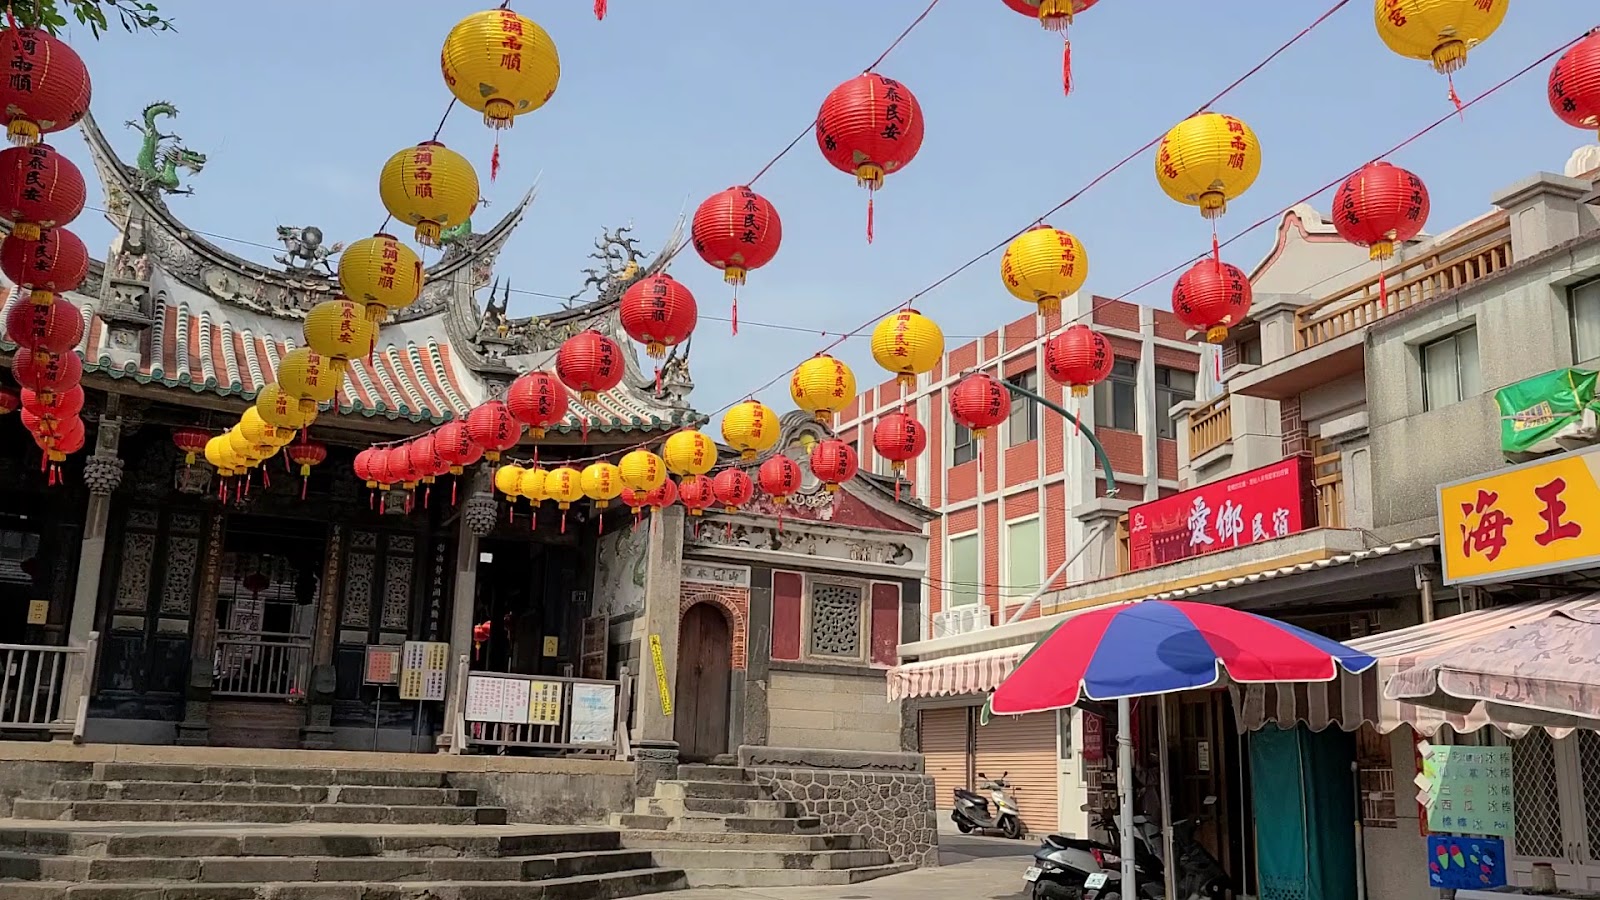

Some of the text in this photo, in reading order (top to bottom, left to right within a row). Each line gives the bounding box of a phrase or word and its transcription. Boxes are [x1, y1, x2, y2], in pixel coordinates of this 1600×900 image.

[500, 12, 523, 72] 風調雨順
[881, 77, 906, 141] 國泰民安
[1221, 115, 1246, 171] 風調雨順
[21, 147, 49, 203] 國泰民安
[414, 146, 435, 199] 風調雨順
[740, 191, 762, 244] 國泰民安
[1341, 179, 1360, 225] 天后宮
[34, 229, 54, 272] 泰民安
[377, 240, 399, 290] 風調雨順
[1055, 229, 1075, 278] 風調雨順
[31, 304, 50, 338] 調雨順
[337, 302, 356, 344] 國泰民安
[650, 278, 669, 323] 風調雨順
[598, 336, 614, 378] 風調雨順
[893, 314, 911, 358] 國泰民安
[537, 378, 551, 415] 國泰民安
[832, 359, 847, 398] 國泰民安
[751, 405, 764, 439] 風調雨順
[1187, 495, 1290, 547] 愛鄉民宿
[1459, 477, 1583, 562] 海王
[34, 602, 44, 620] 出口
[547, 638, 556, 654] 入口
